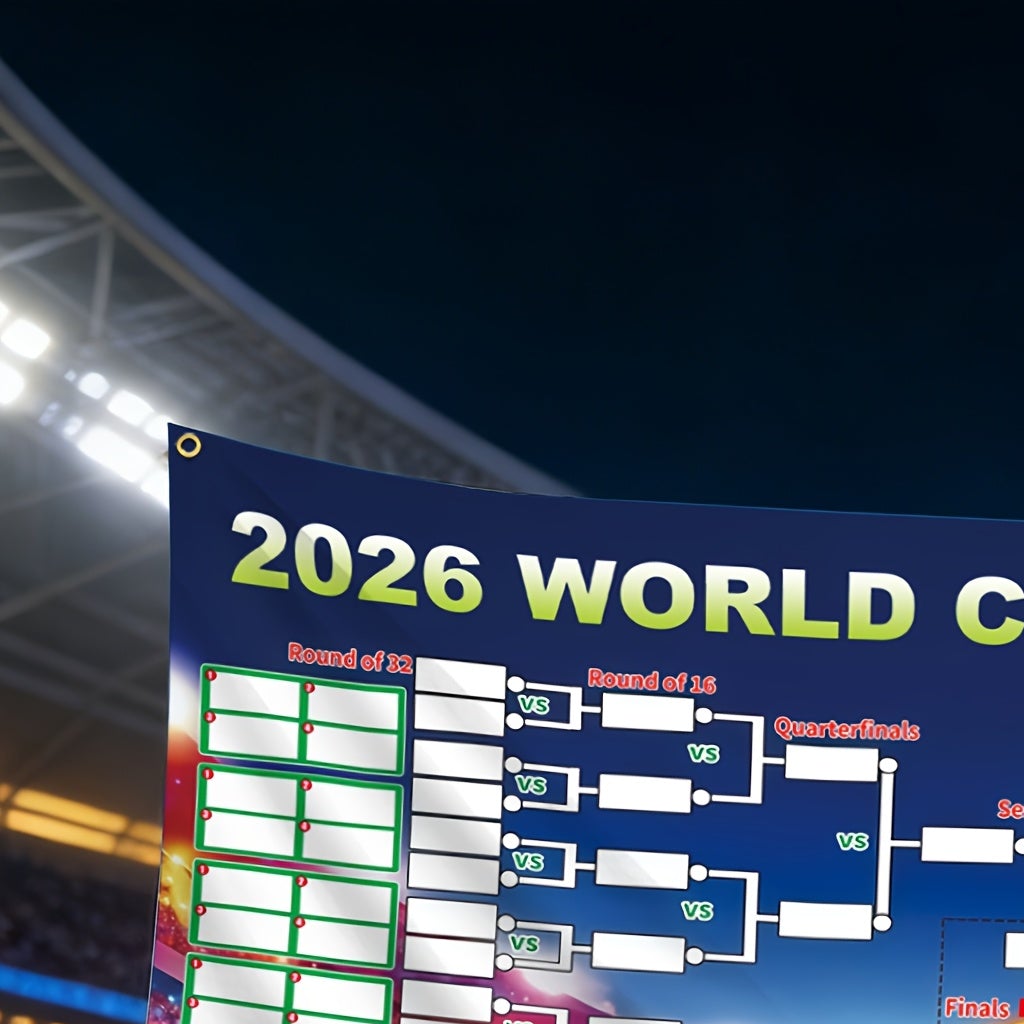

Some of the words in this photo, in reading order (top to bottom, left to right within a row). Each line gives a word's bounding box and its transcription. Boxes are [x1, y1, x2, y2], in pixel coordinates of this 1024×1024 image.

[231, 511, 483, 612] 2026
[517, 554, 915, 641] WORLD
[288, 642, 357, 669] Round
[360, 650, 385, 672] of
[386, 653, 413, 674] 32
[588, 668, 659, 690] Round
[662, 672, 687, 692] of
[690, 675, 716, 695] 16
[774, 716, 920, 742] Quarterfinals
[945, 996, 1010, 1019] Finals
